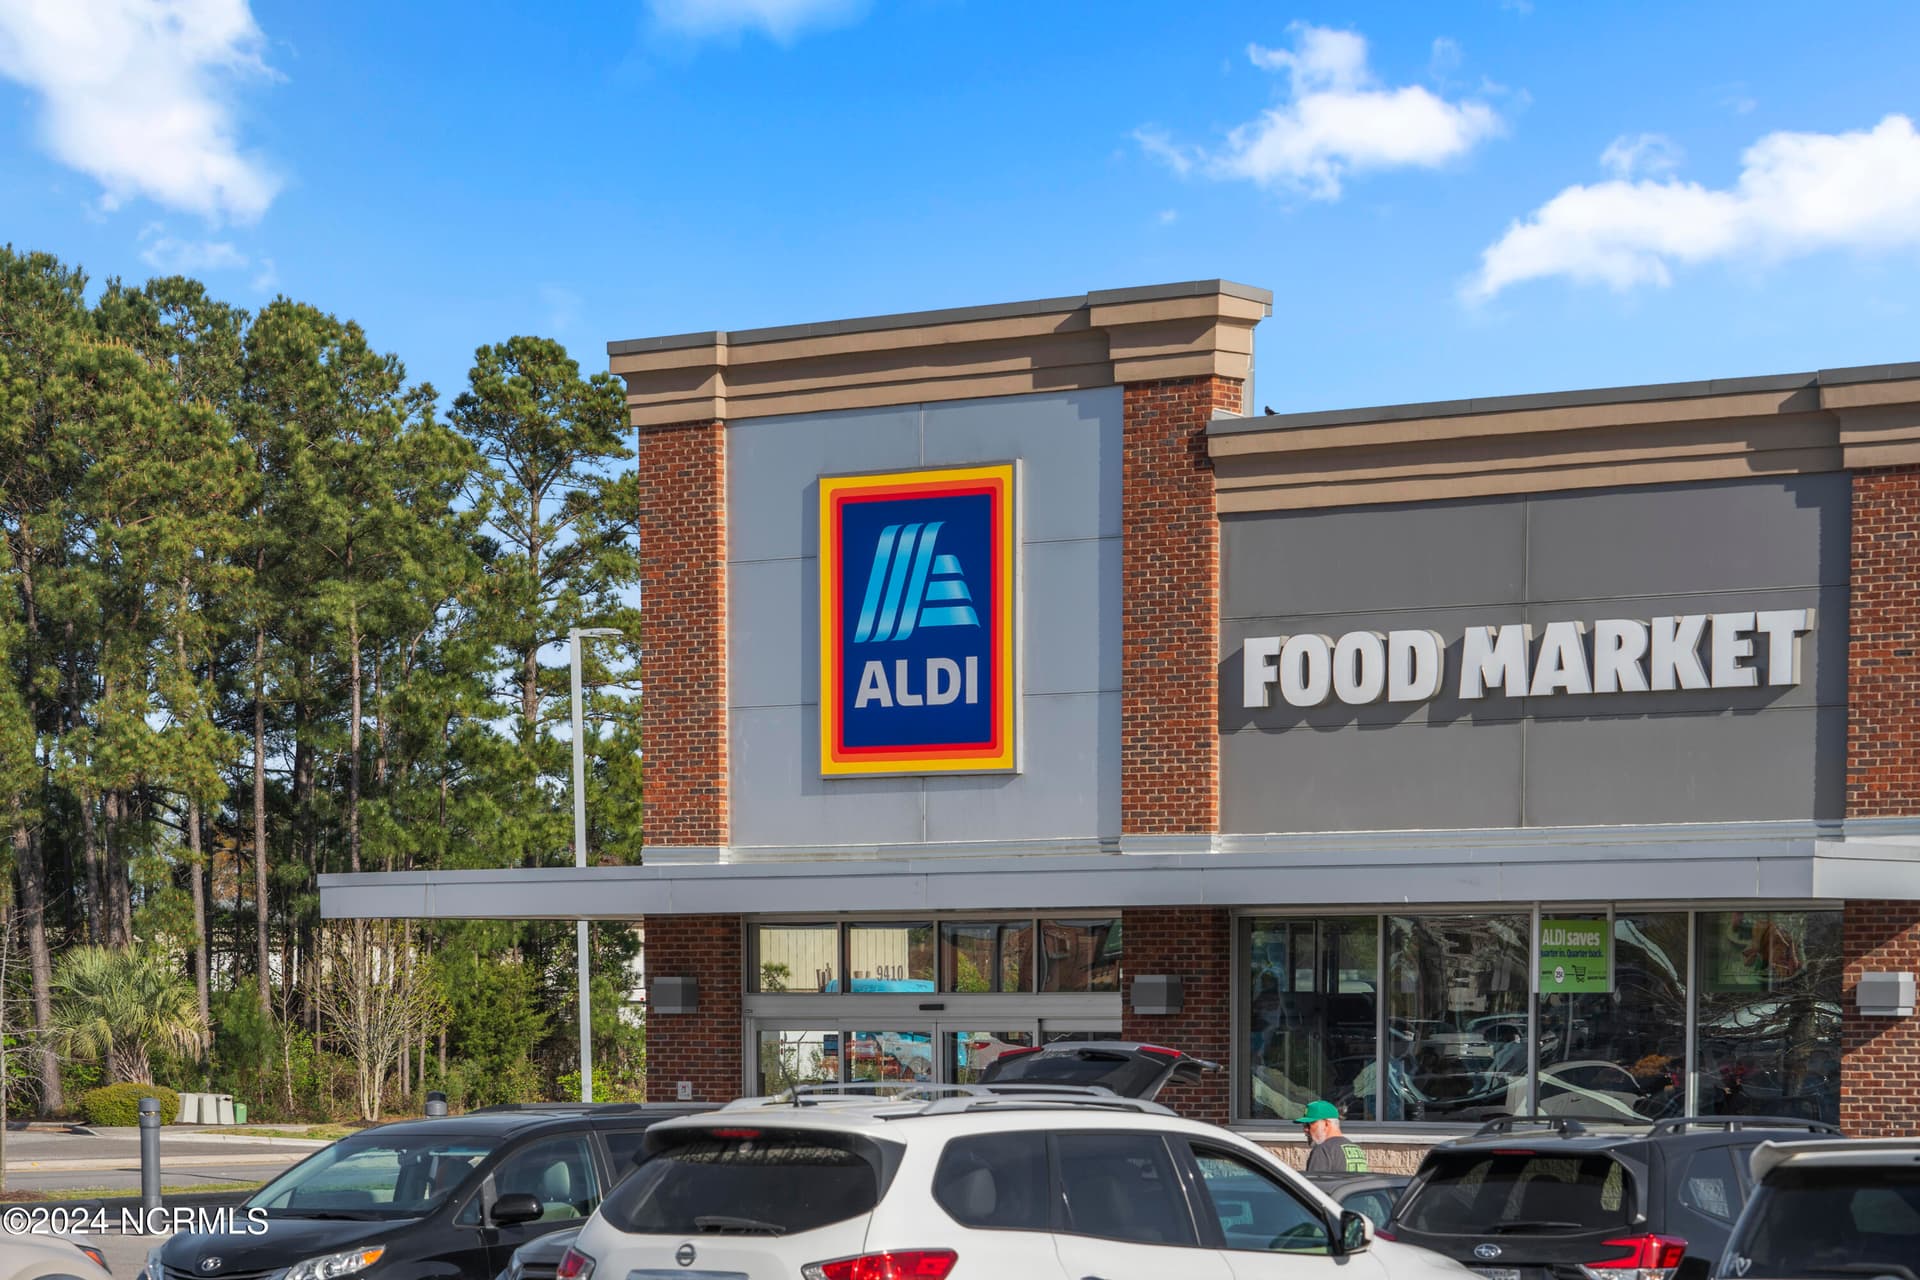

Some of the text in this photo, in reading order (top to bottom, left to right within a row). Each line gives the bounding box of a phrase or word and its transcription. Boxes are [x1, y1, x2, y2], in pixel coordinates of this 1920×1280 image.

[1243, 608, 1815, 708] FOOD MARKET
[854, 655, 978, 708] ALDI
[1542, 928, 1600, 946] ALDI saves
[876, 965, 903, 981] 9410
